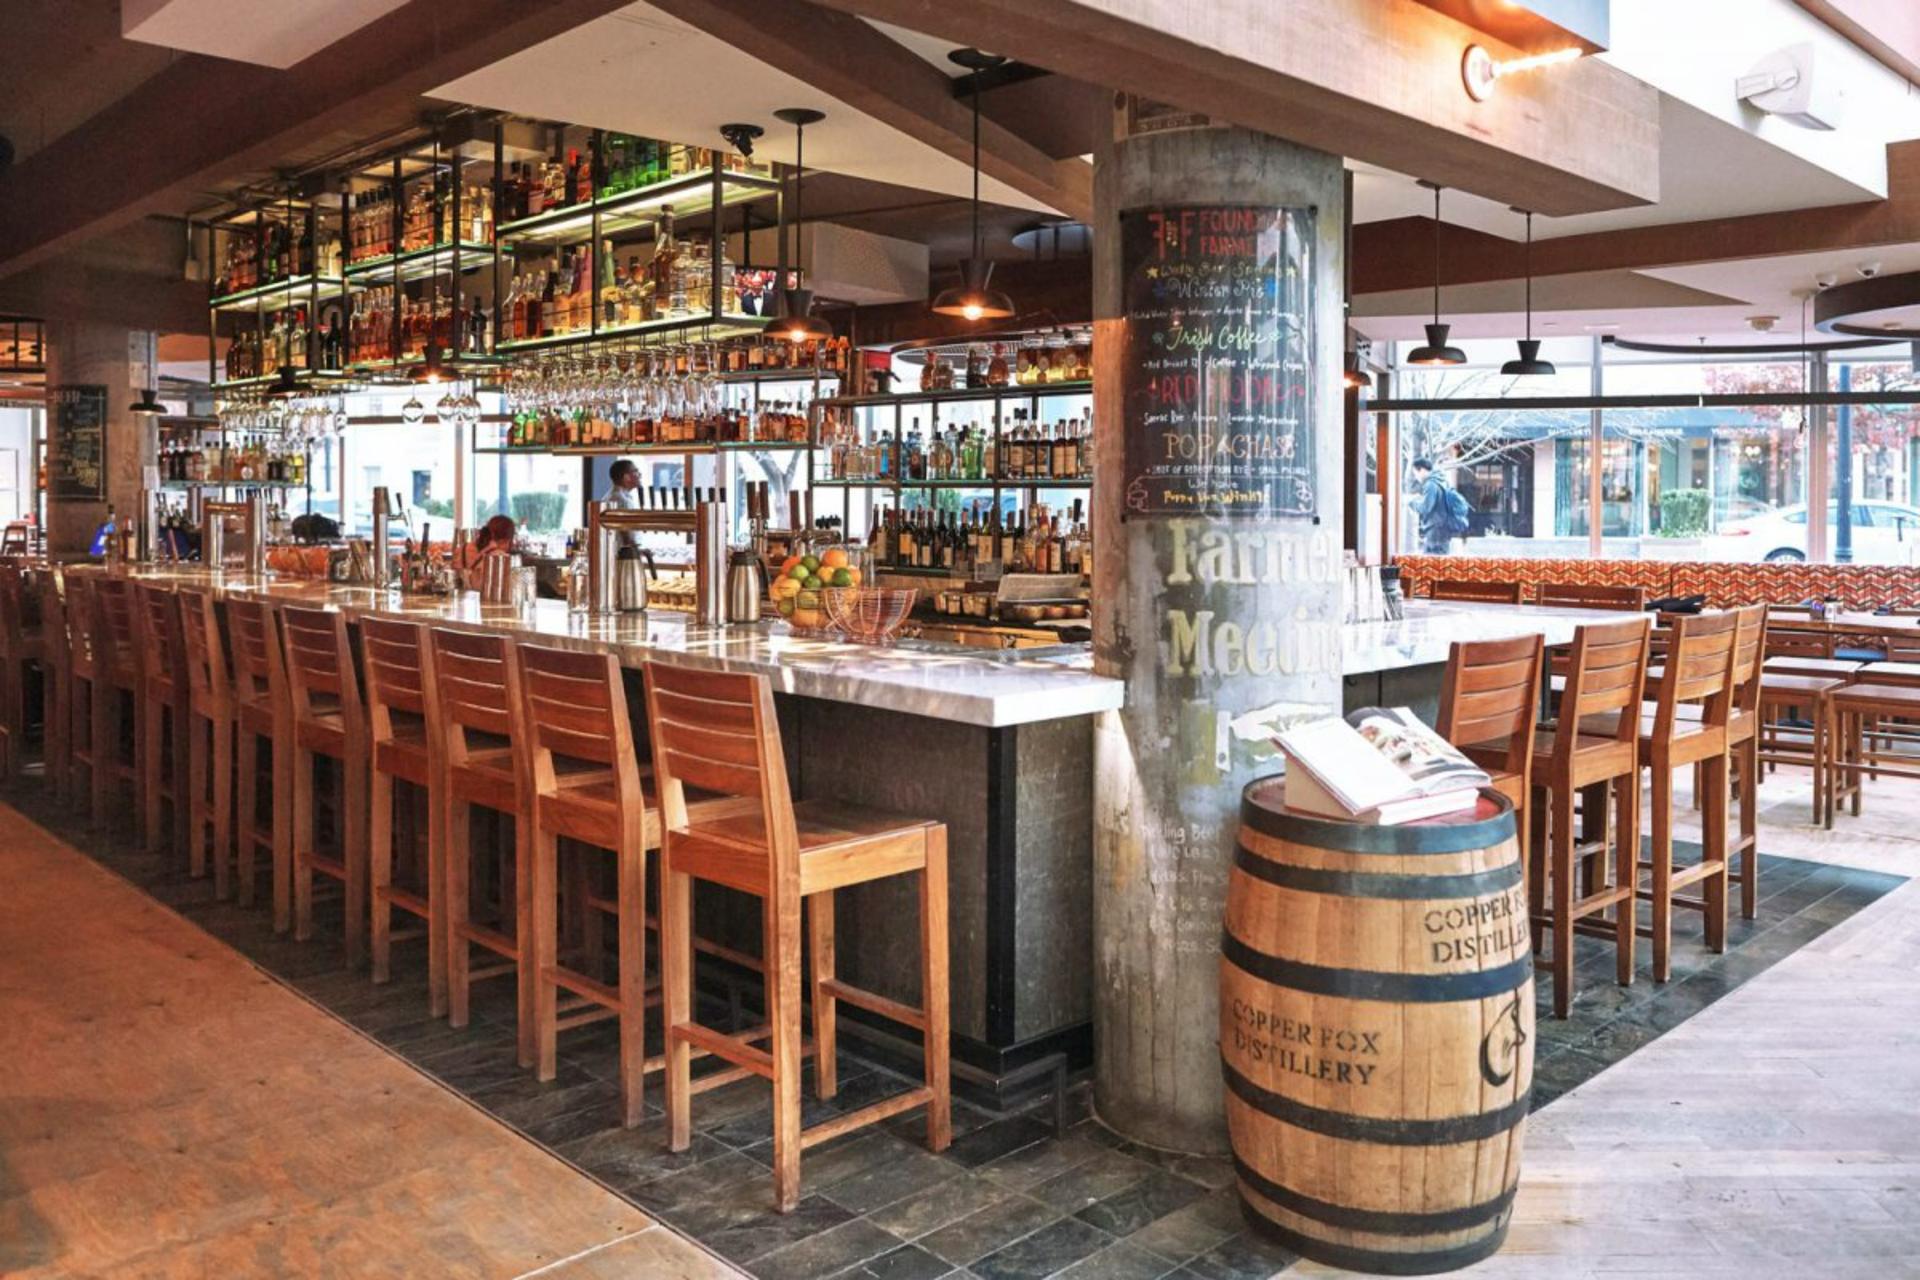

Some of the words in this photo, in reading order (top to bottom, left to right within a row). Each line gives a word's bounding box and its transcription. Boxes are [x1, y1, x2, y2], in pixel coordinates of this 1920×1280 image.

[1166, 326, 1213, 351] Irish
[1218, 325, 1268, 350] Coffee
[1424, 896, 1512, 934] COPPER
[1232, 998, 1312, 1046] COPPER
[1320, 1027, 1382, 1055] FOX
[1234, 1027, 1376, 1085] DISTILLERY
